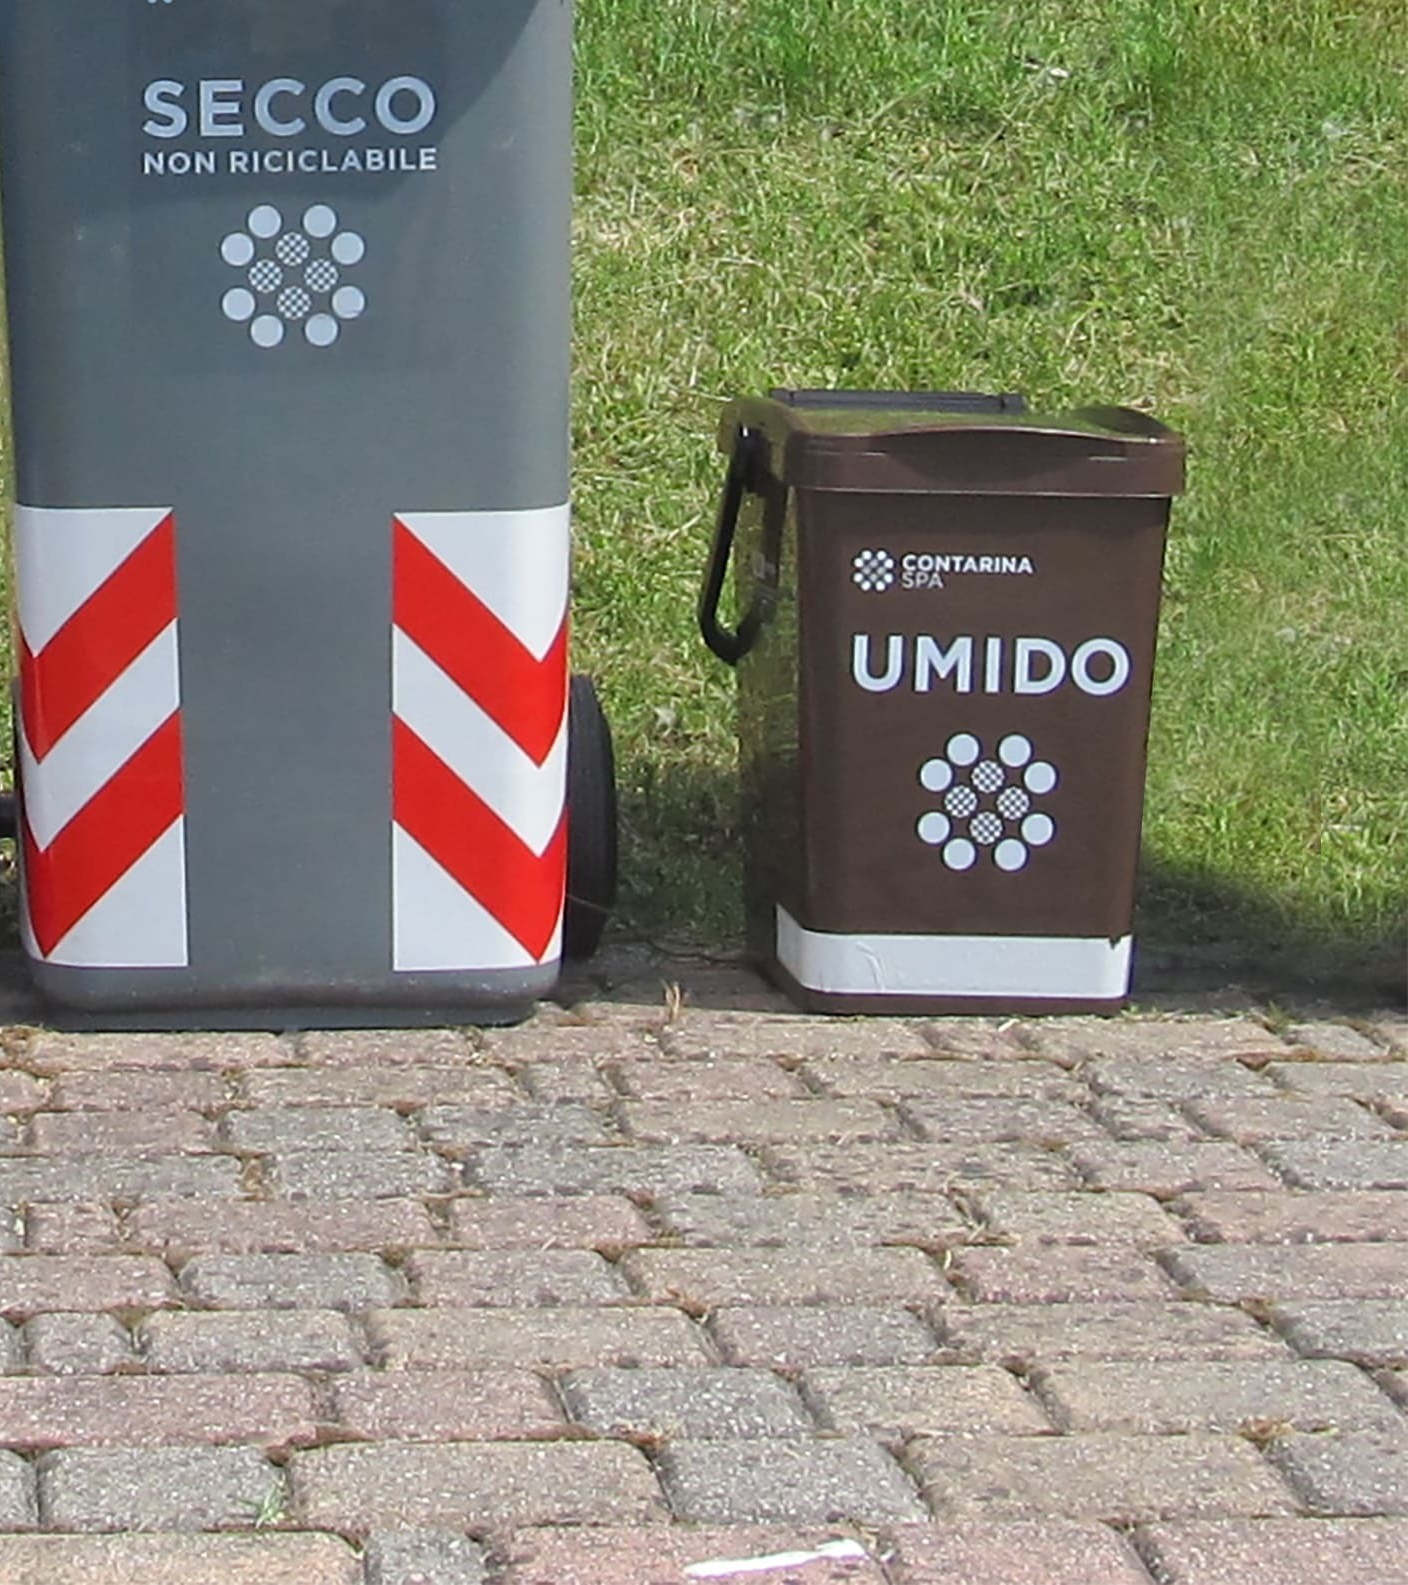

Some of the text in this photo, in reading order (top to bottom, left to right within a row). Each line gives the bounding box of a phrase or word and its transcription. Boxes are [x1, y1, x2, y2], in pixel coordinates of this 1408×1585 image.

[142, 76, 435, 138] SECCO
[143, 147, 438, 175] NON RICICLABILE
[902, 554, 1034, 574] CONTARINA
[902, 572, 944, 590] SPA
[853, 634, 1130, 696] UMIDO
